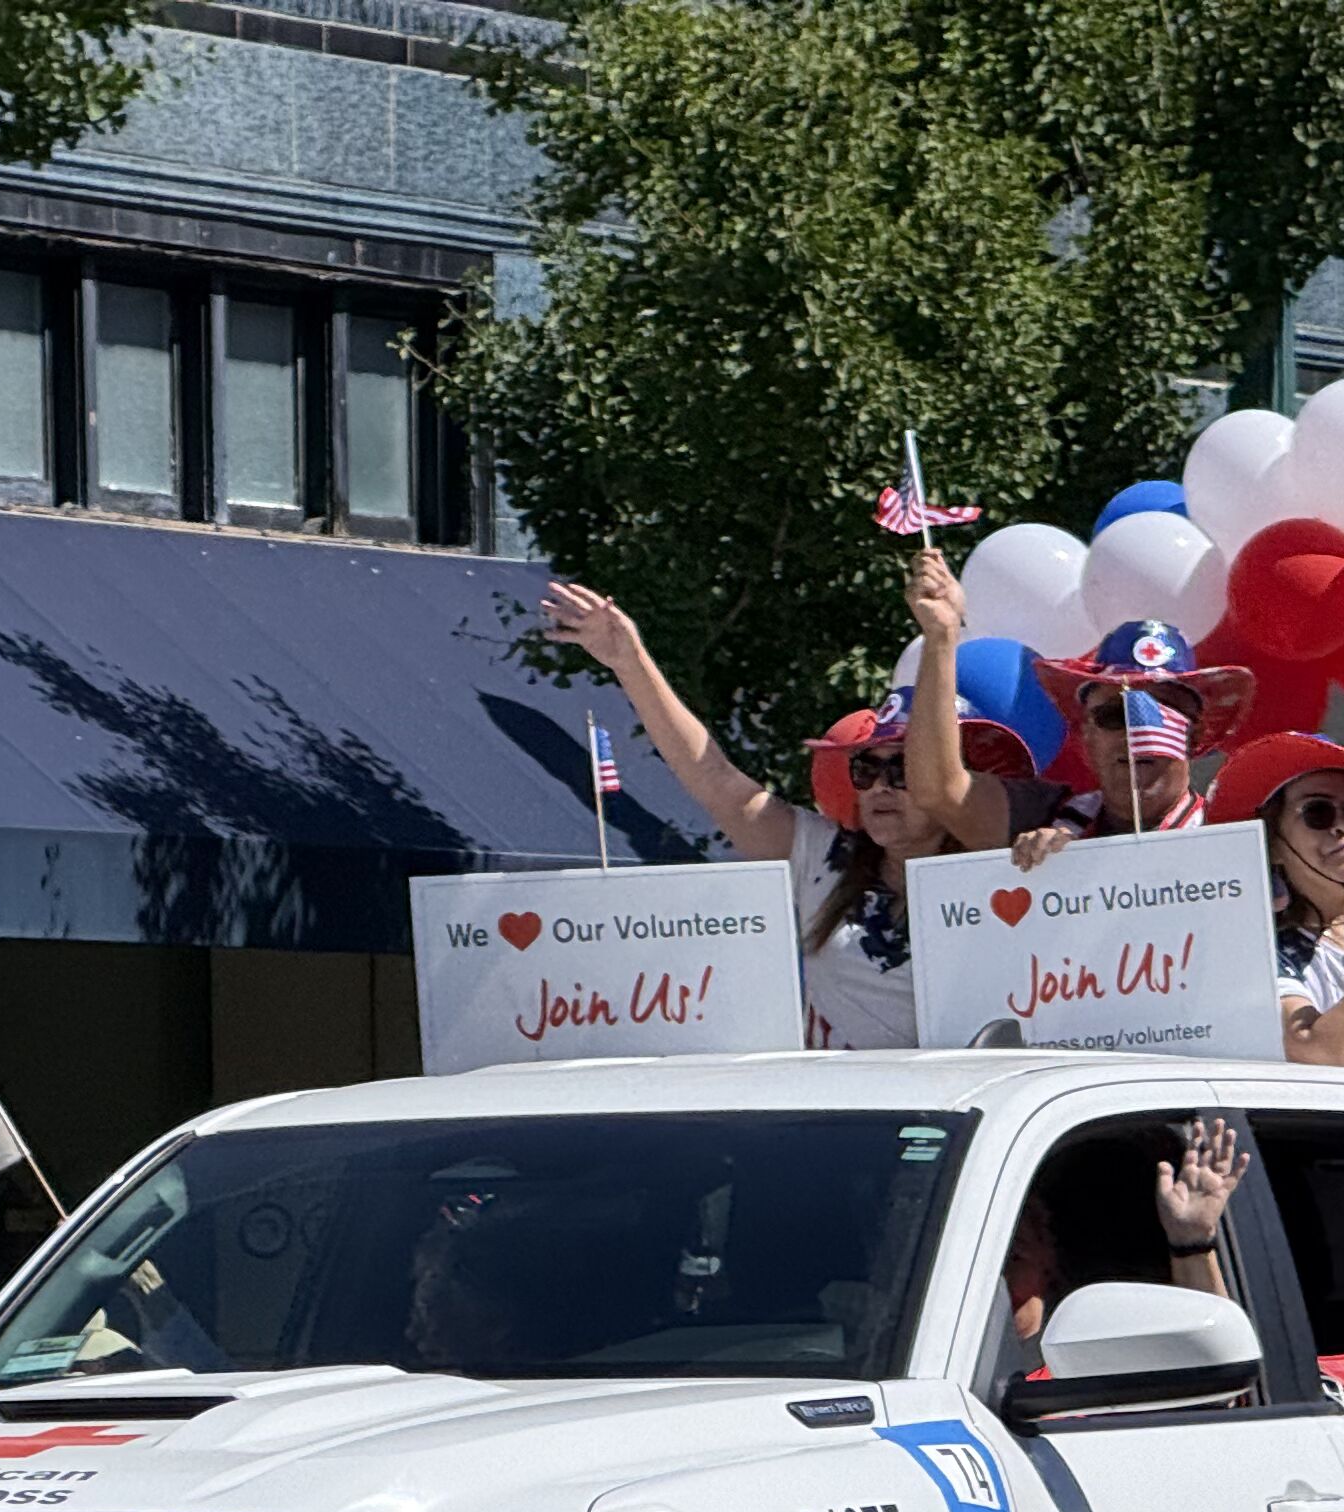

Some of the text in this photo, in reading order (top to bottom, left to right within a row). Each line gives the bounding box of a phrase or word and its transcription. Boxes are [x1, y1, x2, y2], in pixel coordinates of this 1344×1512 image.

[447, 912, 767, 948] We Our Volunteers
[940, 878, 1243, 928] We Our Volunteers
[515, 964, 713, 1042] Join Us!
[1008, 931, 1195, 1018] Join Us!
[939, 1446, 994, 1503] 74
